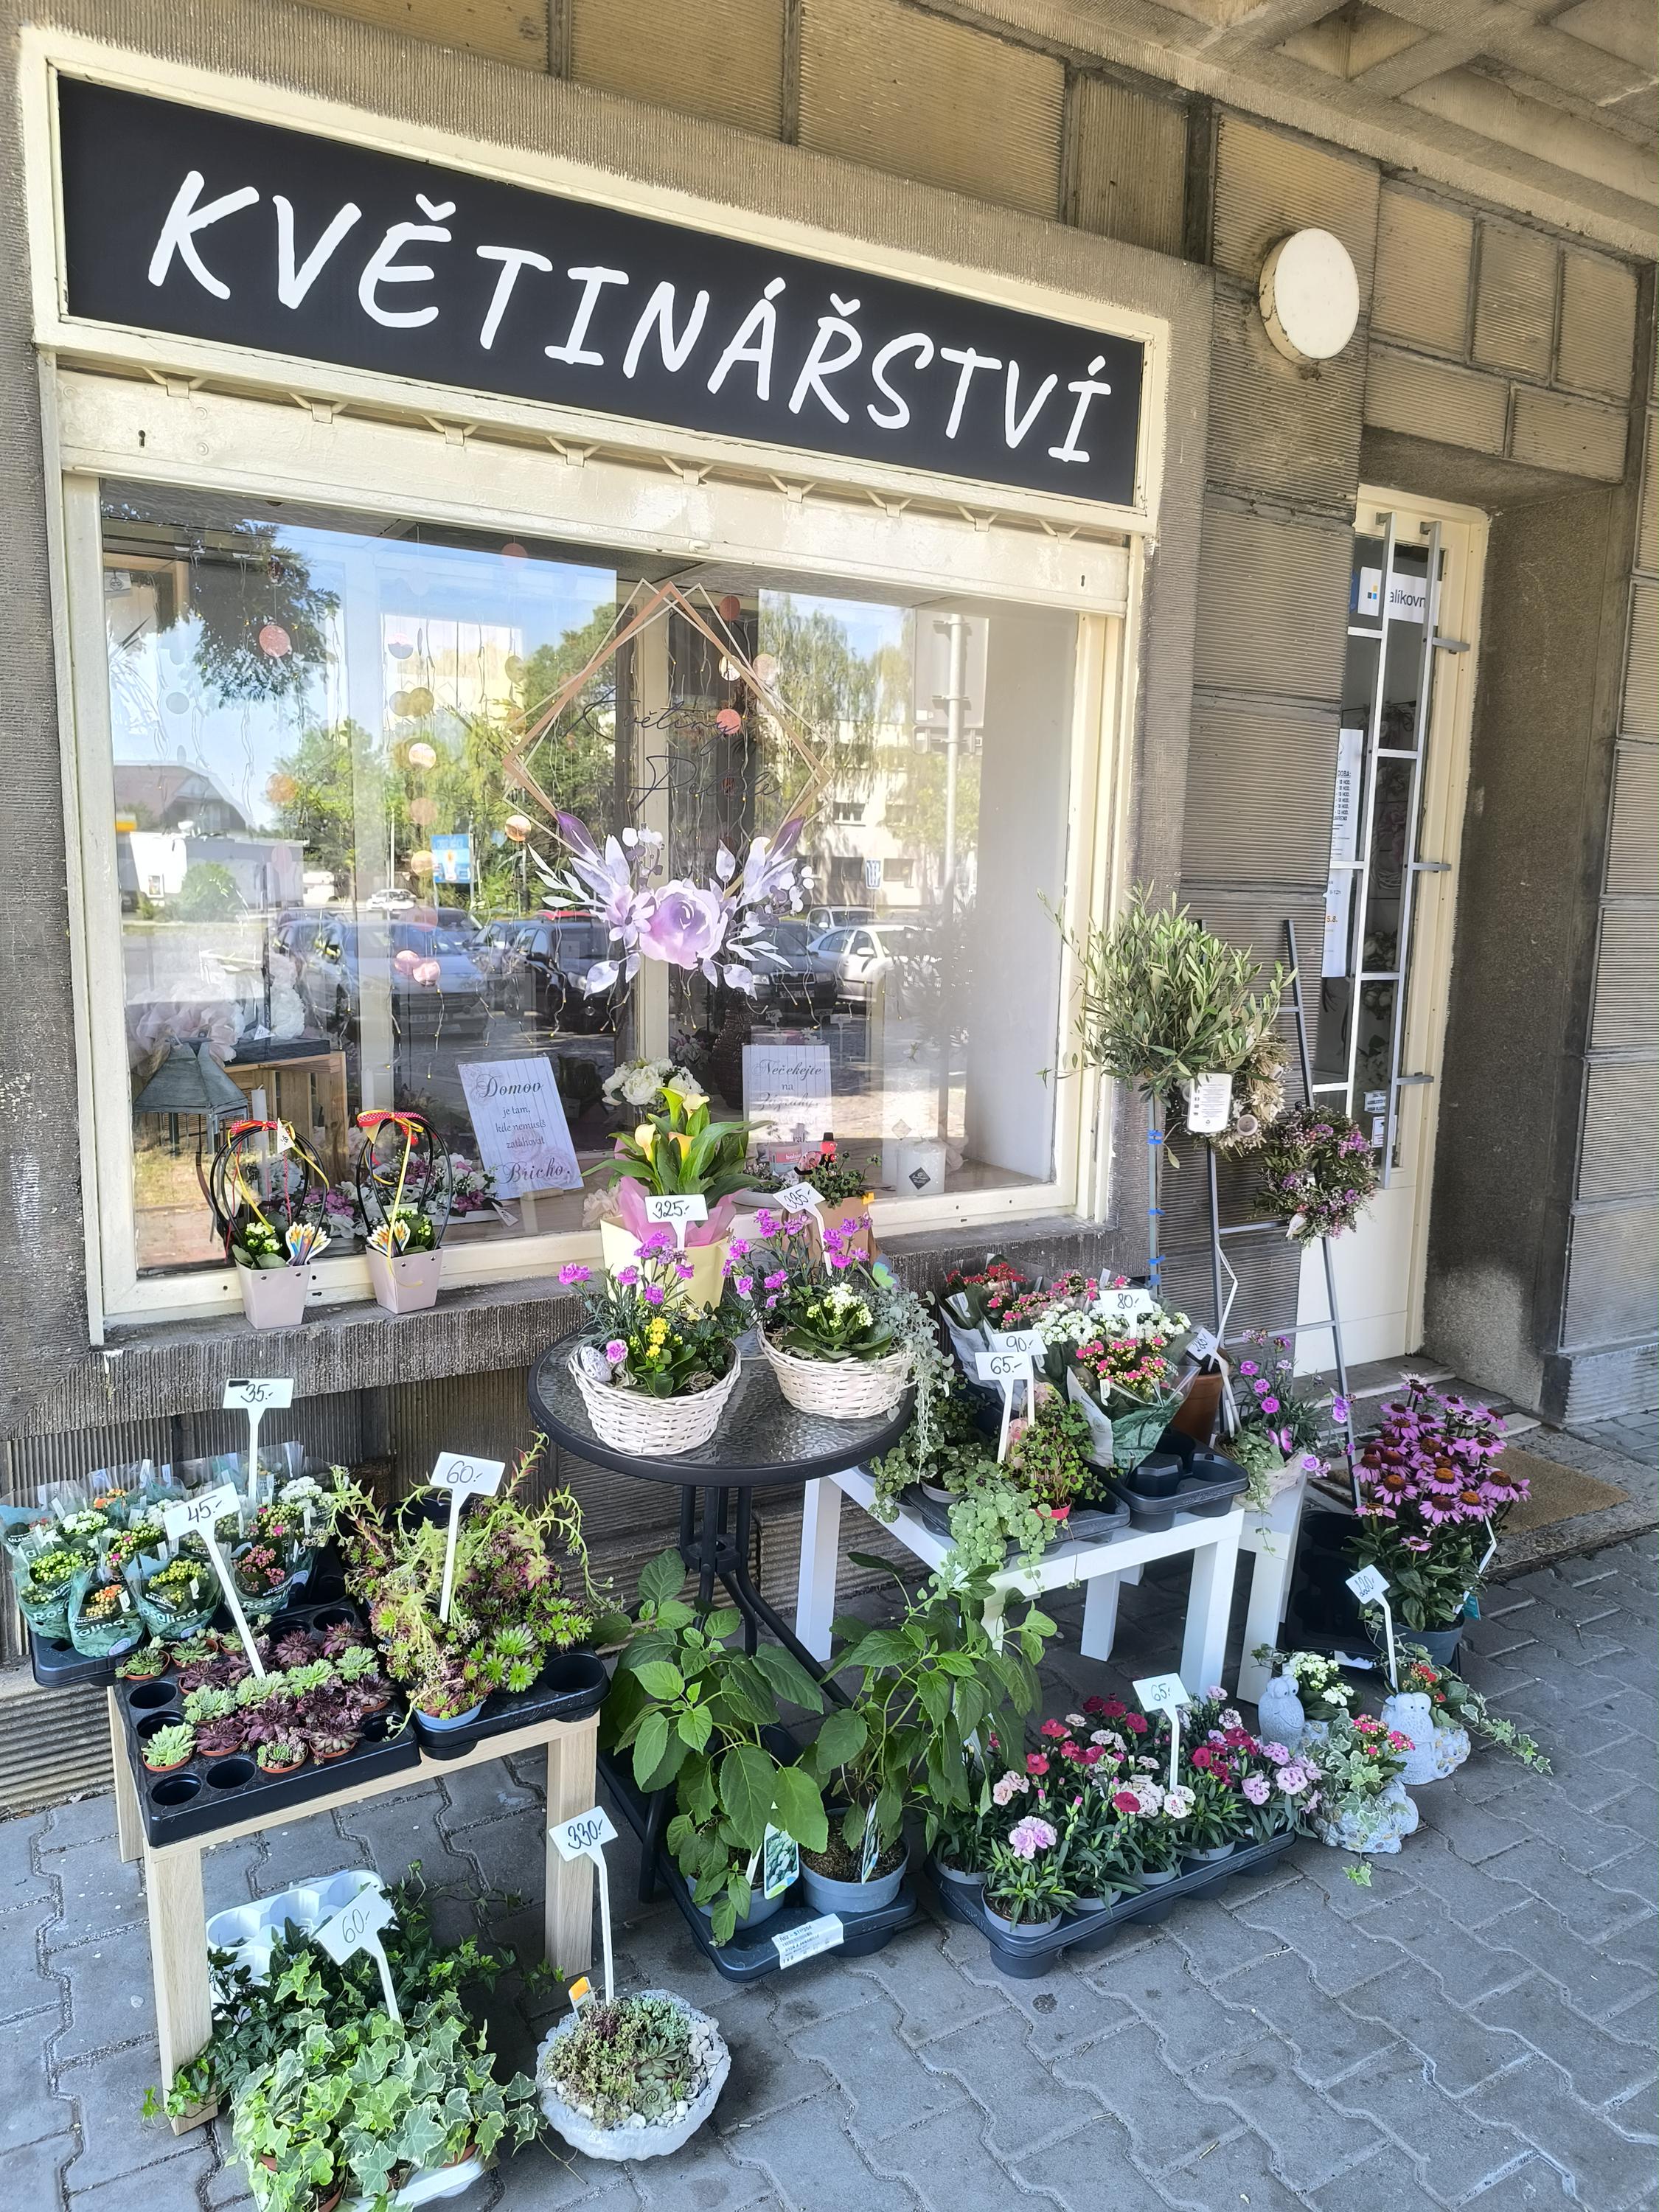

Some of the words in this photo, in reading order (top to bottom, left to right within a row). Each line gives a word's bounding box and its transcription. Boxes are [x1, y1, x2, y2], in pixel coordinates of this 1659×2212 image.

[147, 170, 1112, 463] KVĚTINÁŘSTVÍ
[752, 1059, 822, 1081] Nečekejte
[476, 1074, 544, 1098] Domov
[502, 1108, 510, 1119] je
[512, 1107, 531, 1116] tam,
[495, 1122, 511, 1133] kde
